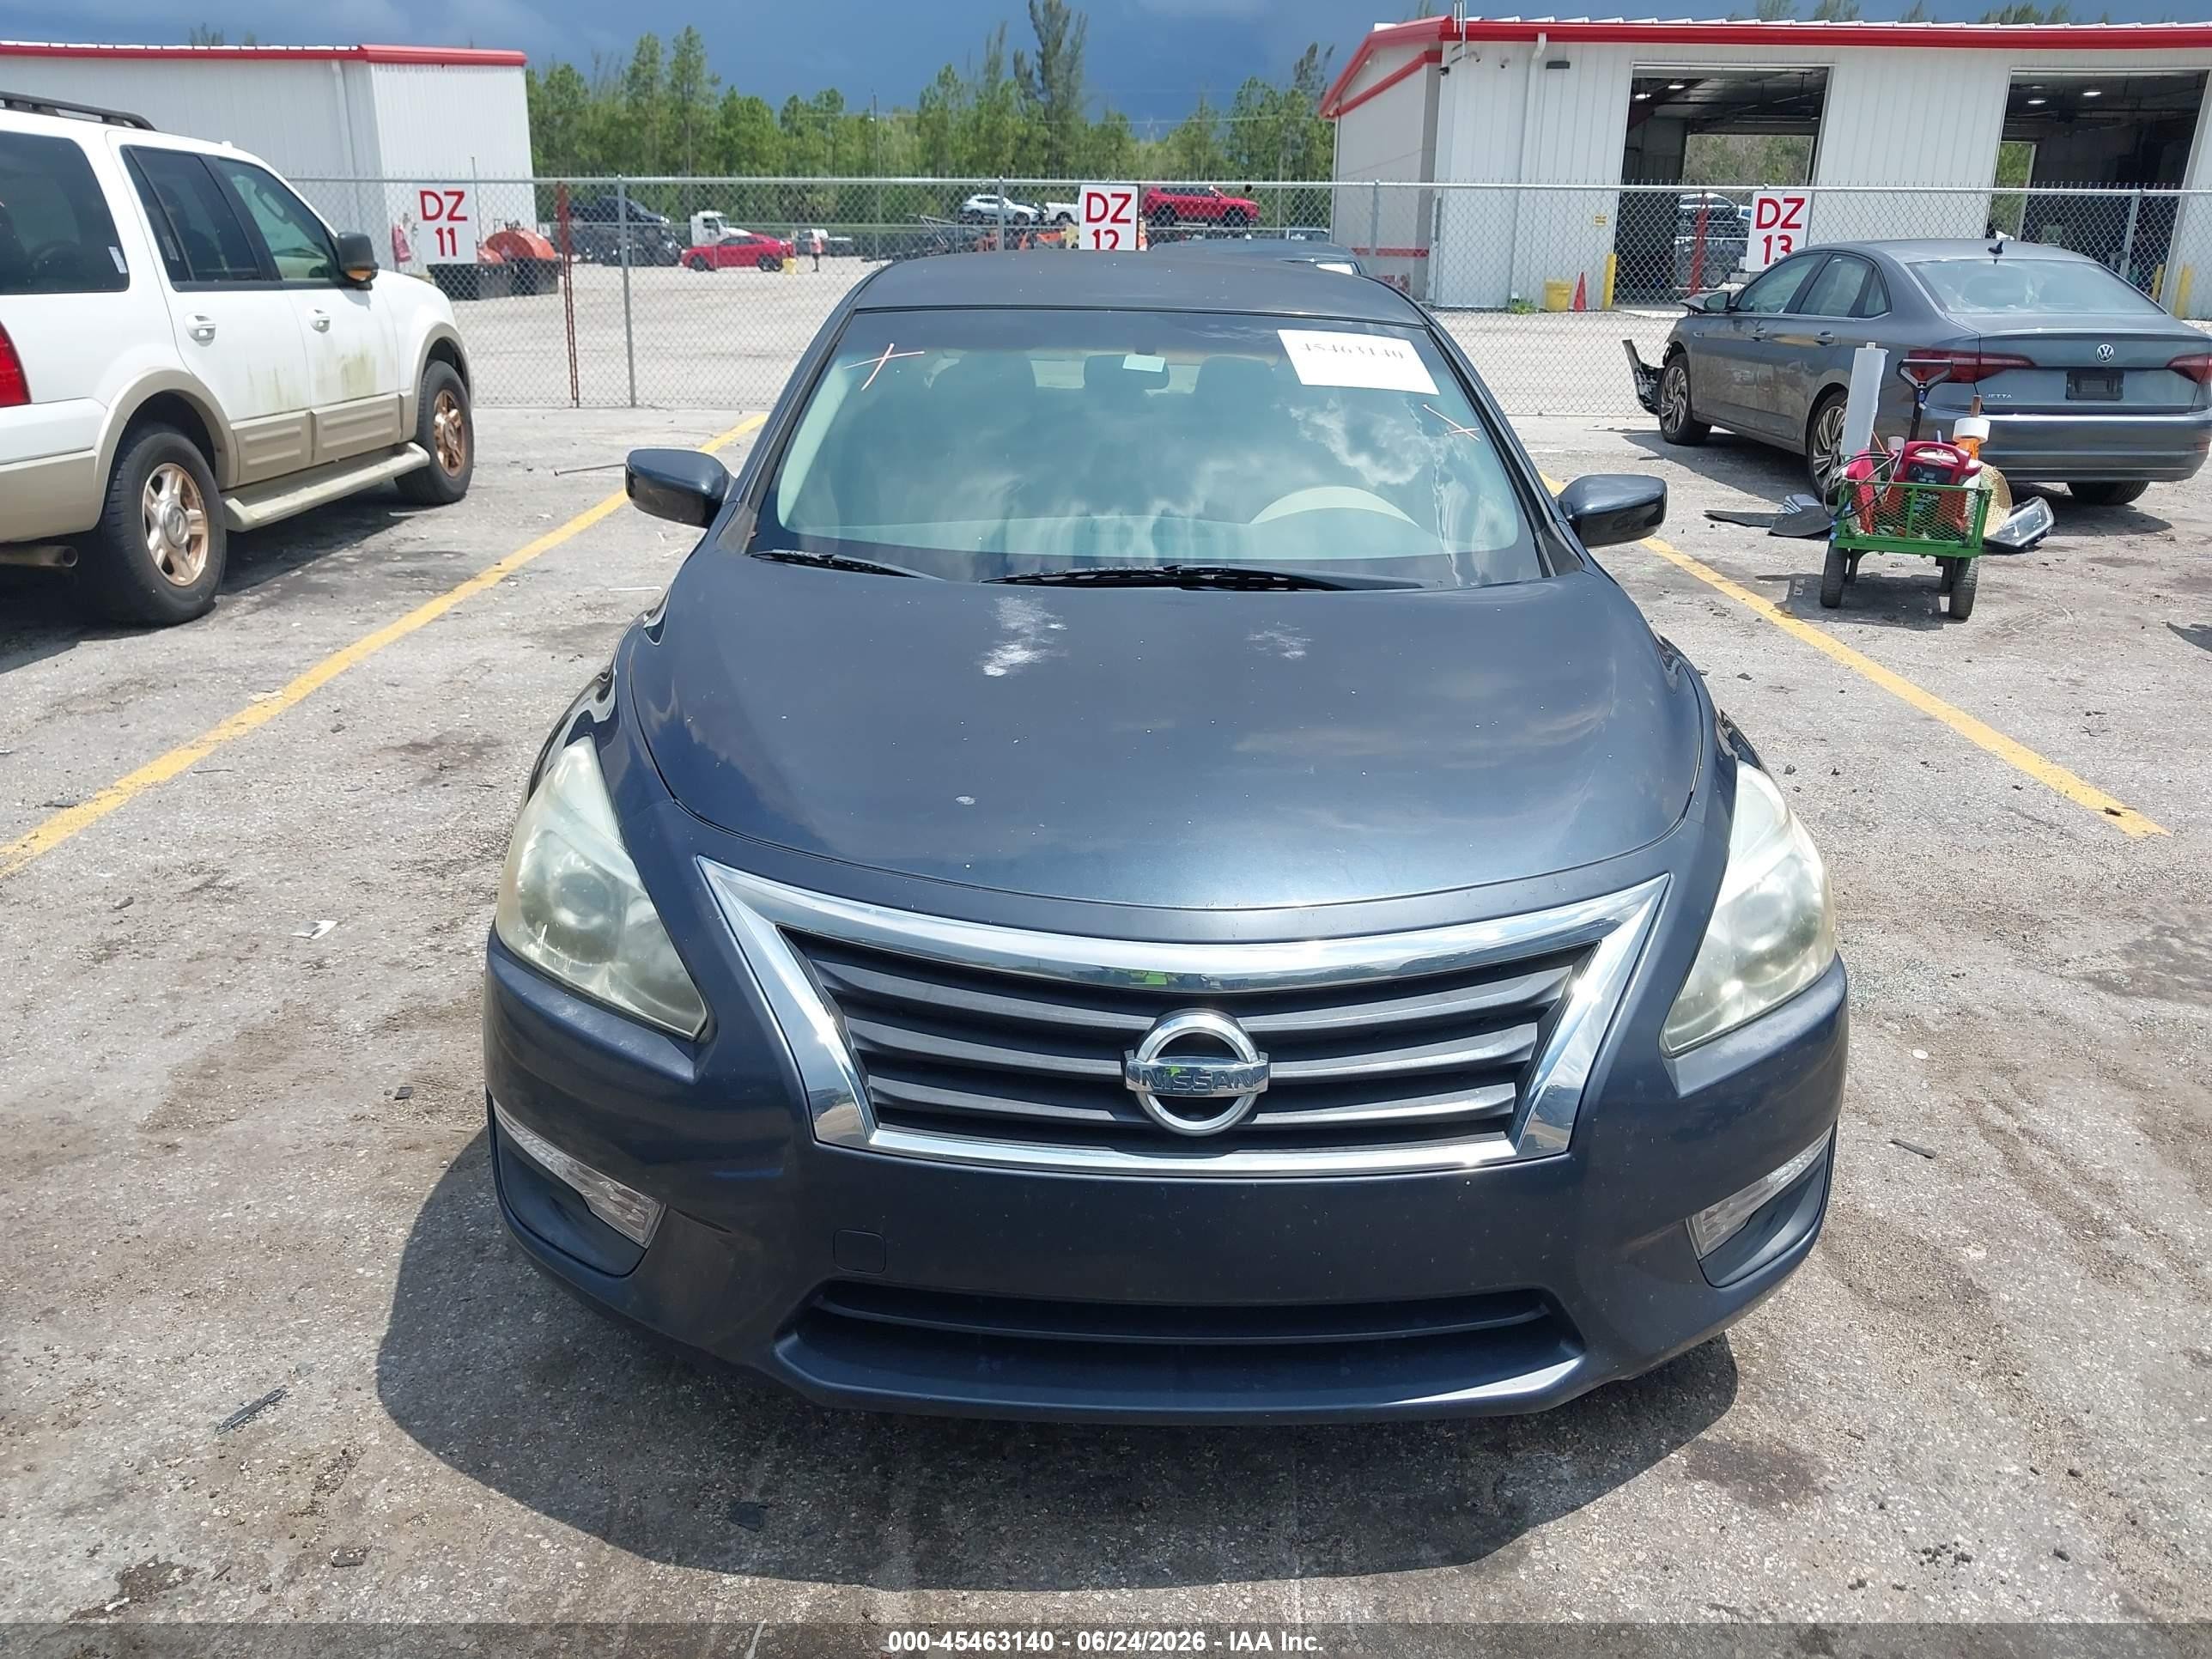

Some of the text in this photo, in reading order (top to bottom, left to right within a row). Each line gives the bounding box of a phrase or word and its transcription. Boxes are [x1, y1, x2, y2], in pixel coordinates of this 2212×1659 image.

[419, 190, 468, 222] DZ
[1085, 191, 1133, 224] DZ
[1755, 197, 1806, 230] DZ
[434, 227, 458, 258] 11
[1091, 228, 1120, 250] 12
[1762, 234, 1793, 265] 13
[1140, 1069, 1255, 1091] NISSAN
